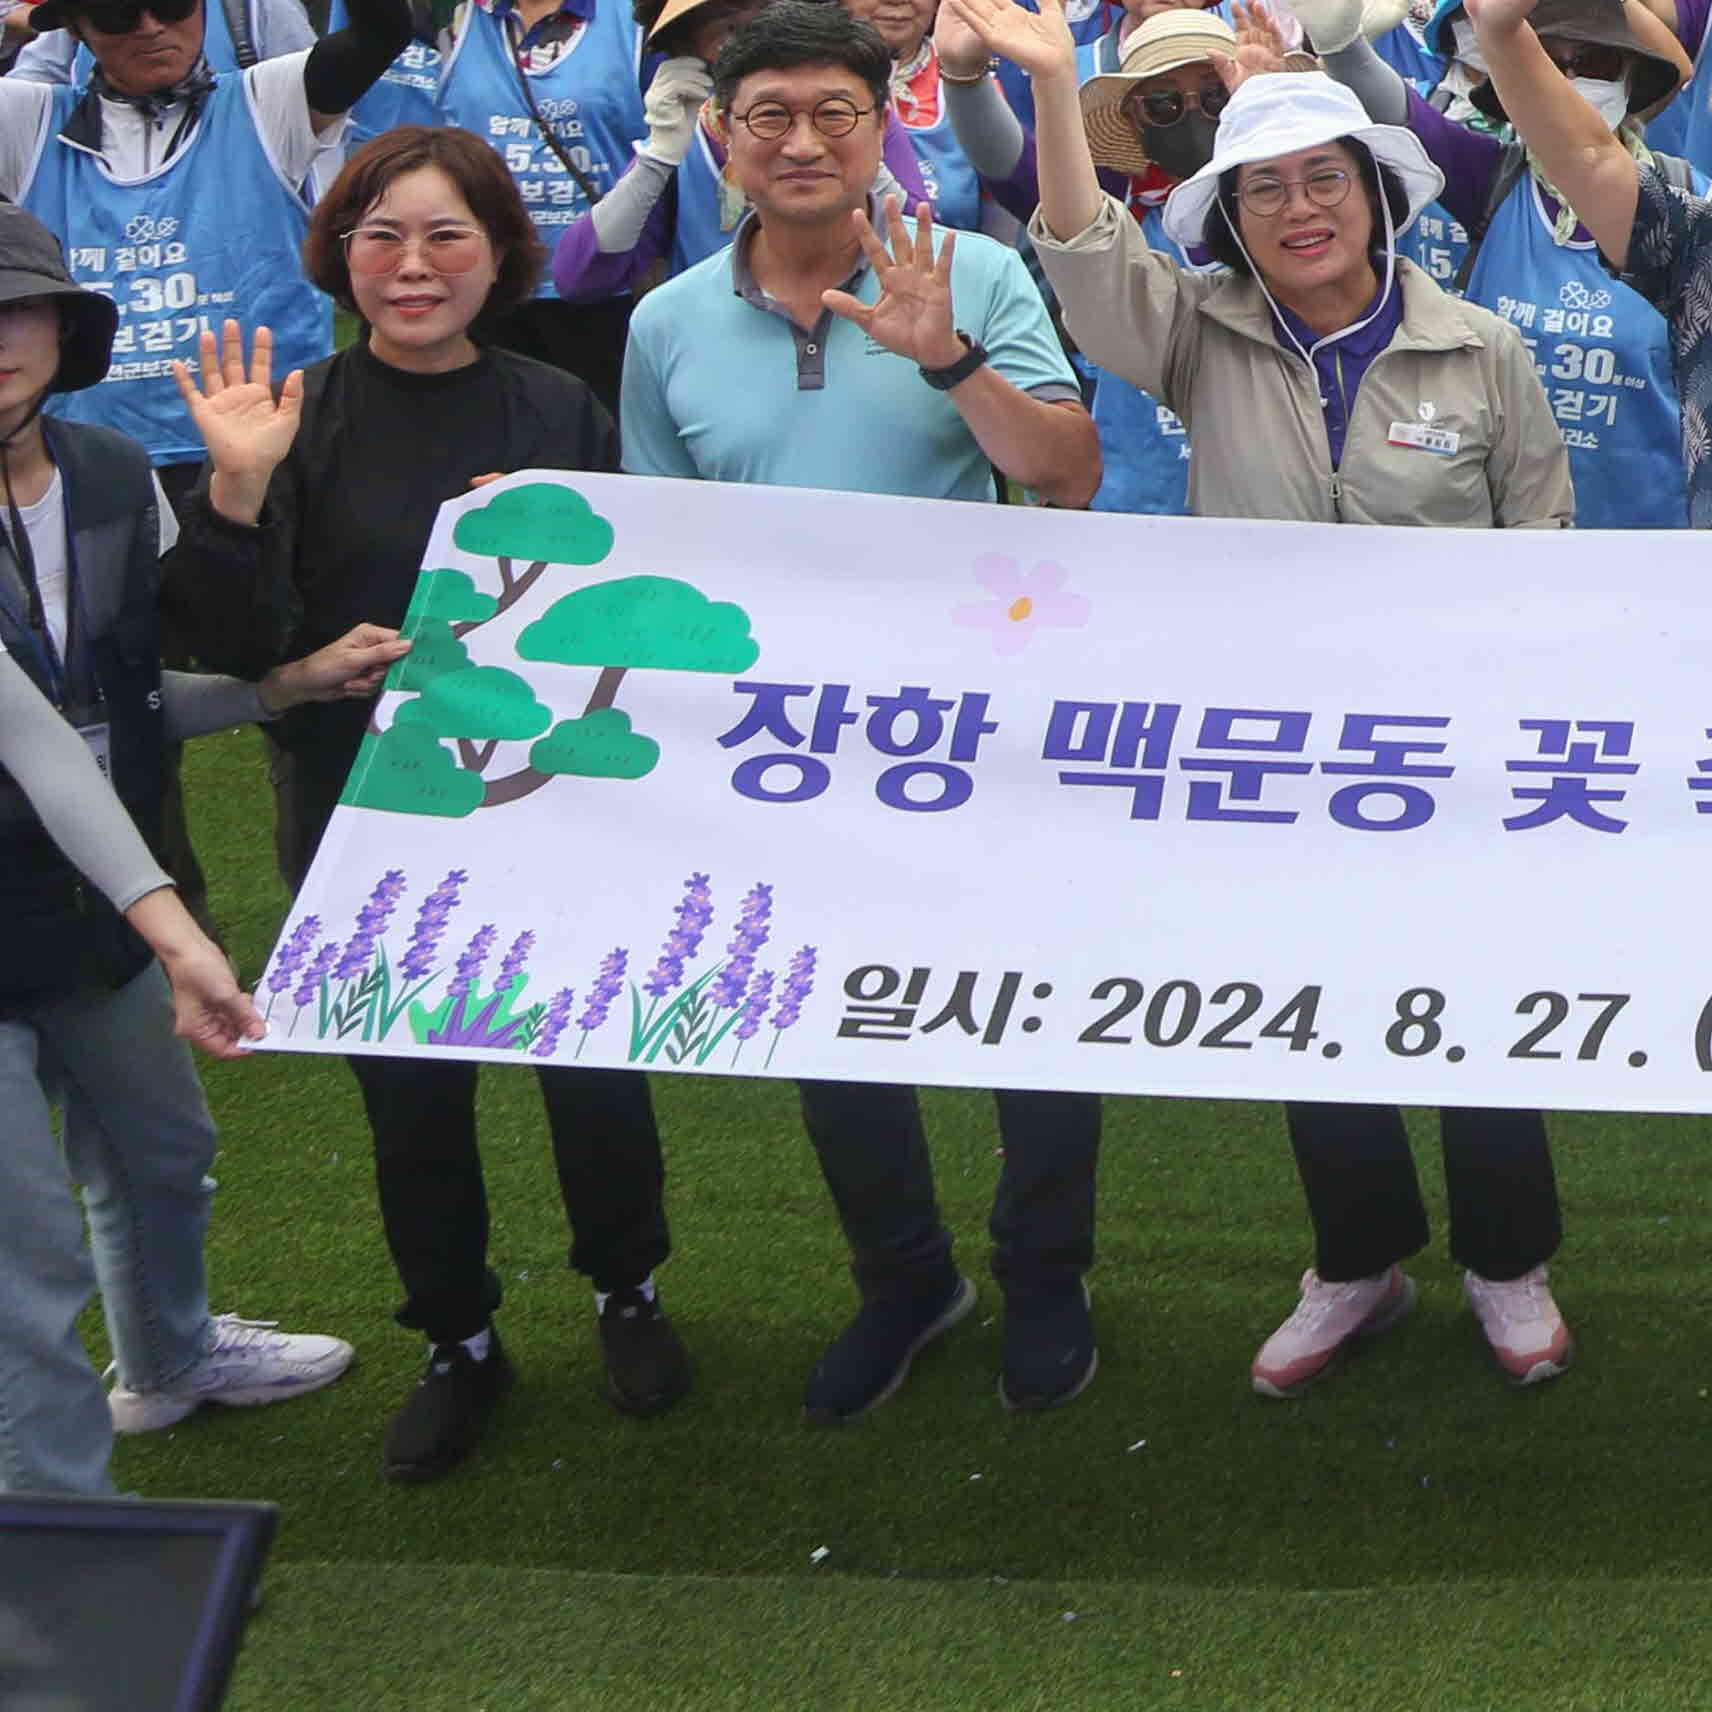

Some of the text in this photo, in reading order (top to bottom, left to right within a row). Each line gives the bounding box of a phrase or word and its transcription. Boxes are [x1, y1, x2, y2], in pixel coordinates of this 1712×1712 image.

[113, 241, 189, 273] 걸어요
[1542, 308, 1614, 338] 걸어요
[715, 679, 1001, 814] 장항
[1040, 698, 1458, 834] 맥문동
[1500, 717, 1642, 835] 꽃
[837, 963, 1054, 1046] 일시:
[1077, 978, 1343, 1060] 2024.
[1384, 987, 1467, 1063] 8.
[1507, 990, 1649, 1070] 27.
